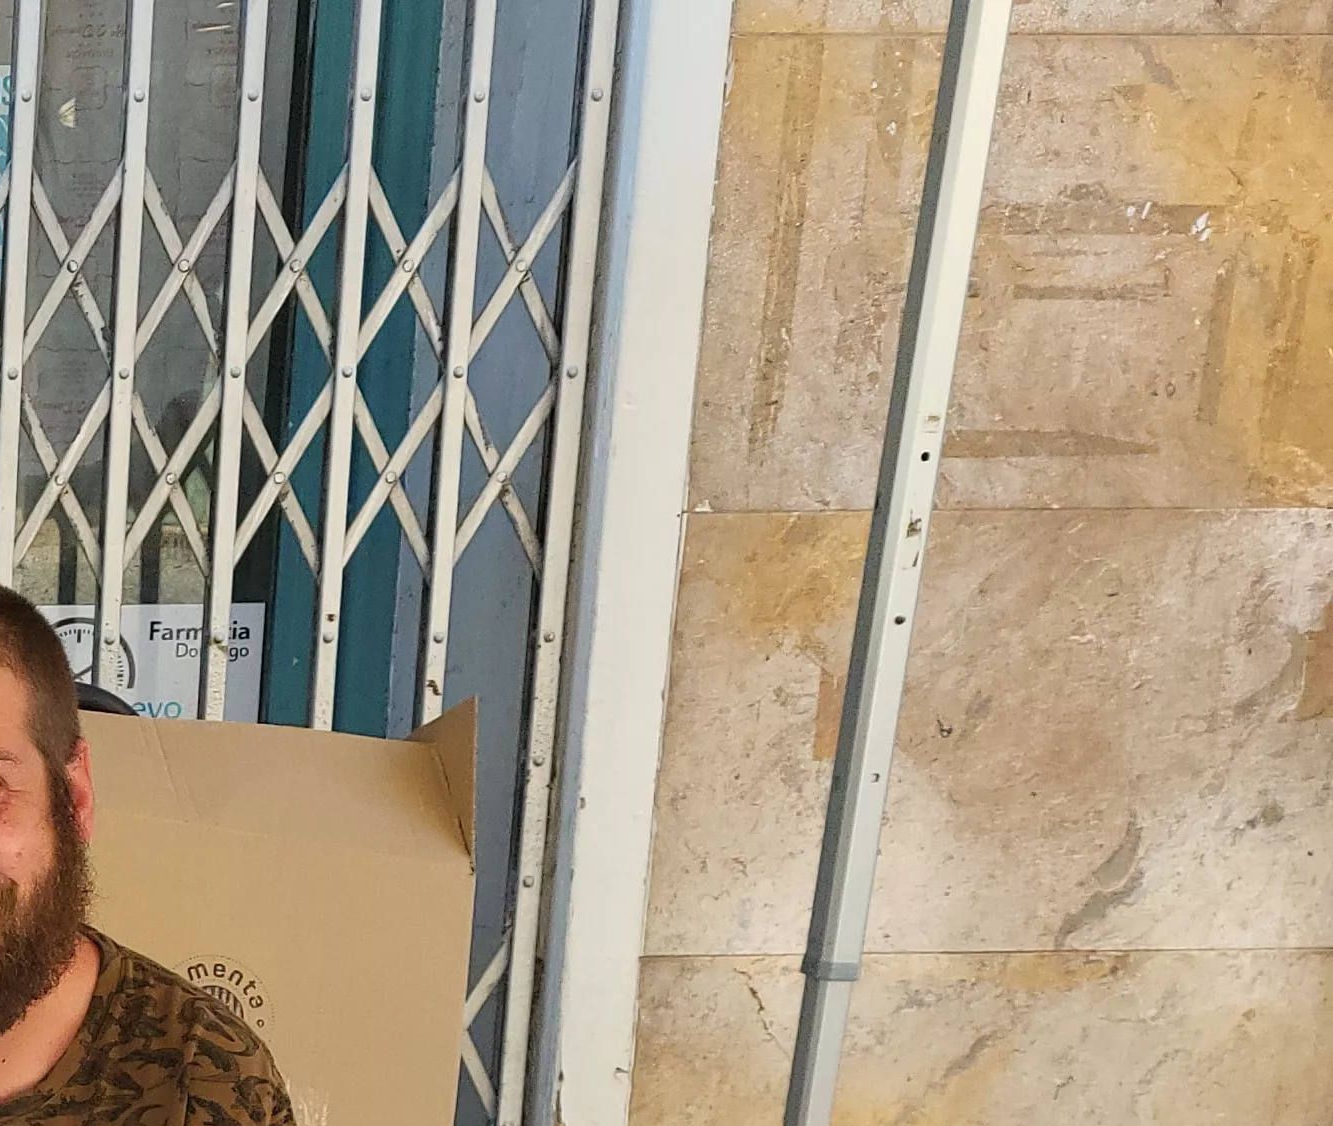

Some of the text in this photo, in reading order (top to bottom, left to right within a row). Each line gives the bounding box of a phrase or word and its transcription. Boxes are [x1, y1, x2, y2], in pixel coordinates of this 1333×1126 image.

[149, 621, 250, 641] Farmia
[175, 643, 250, 661] Dogo
[133, 701, 182, 719] evo
[187, 963, 264, 1009] menta
